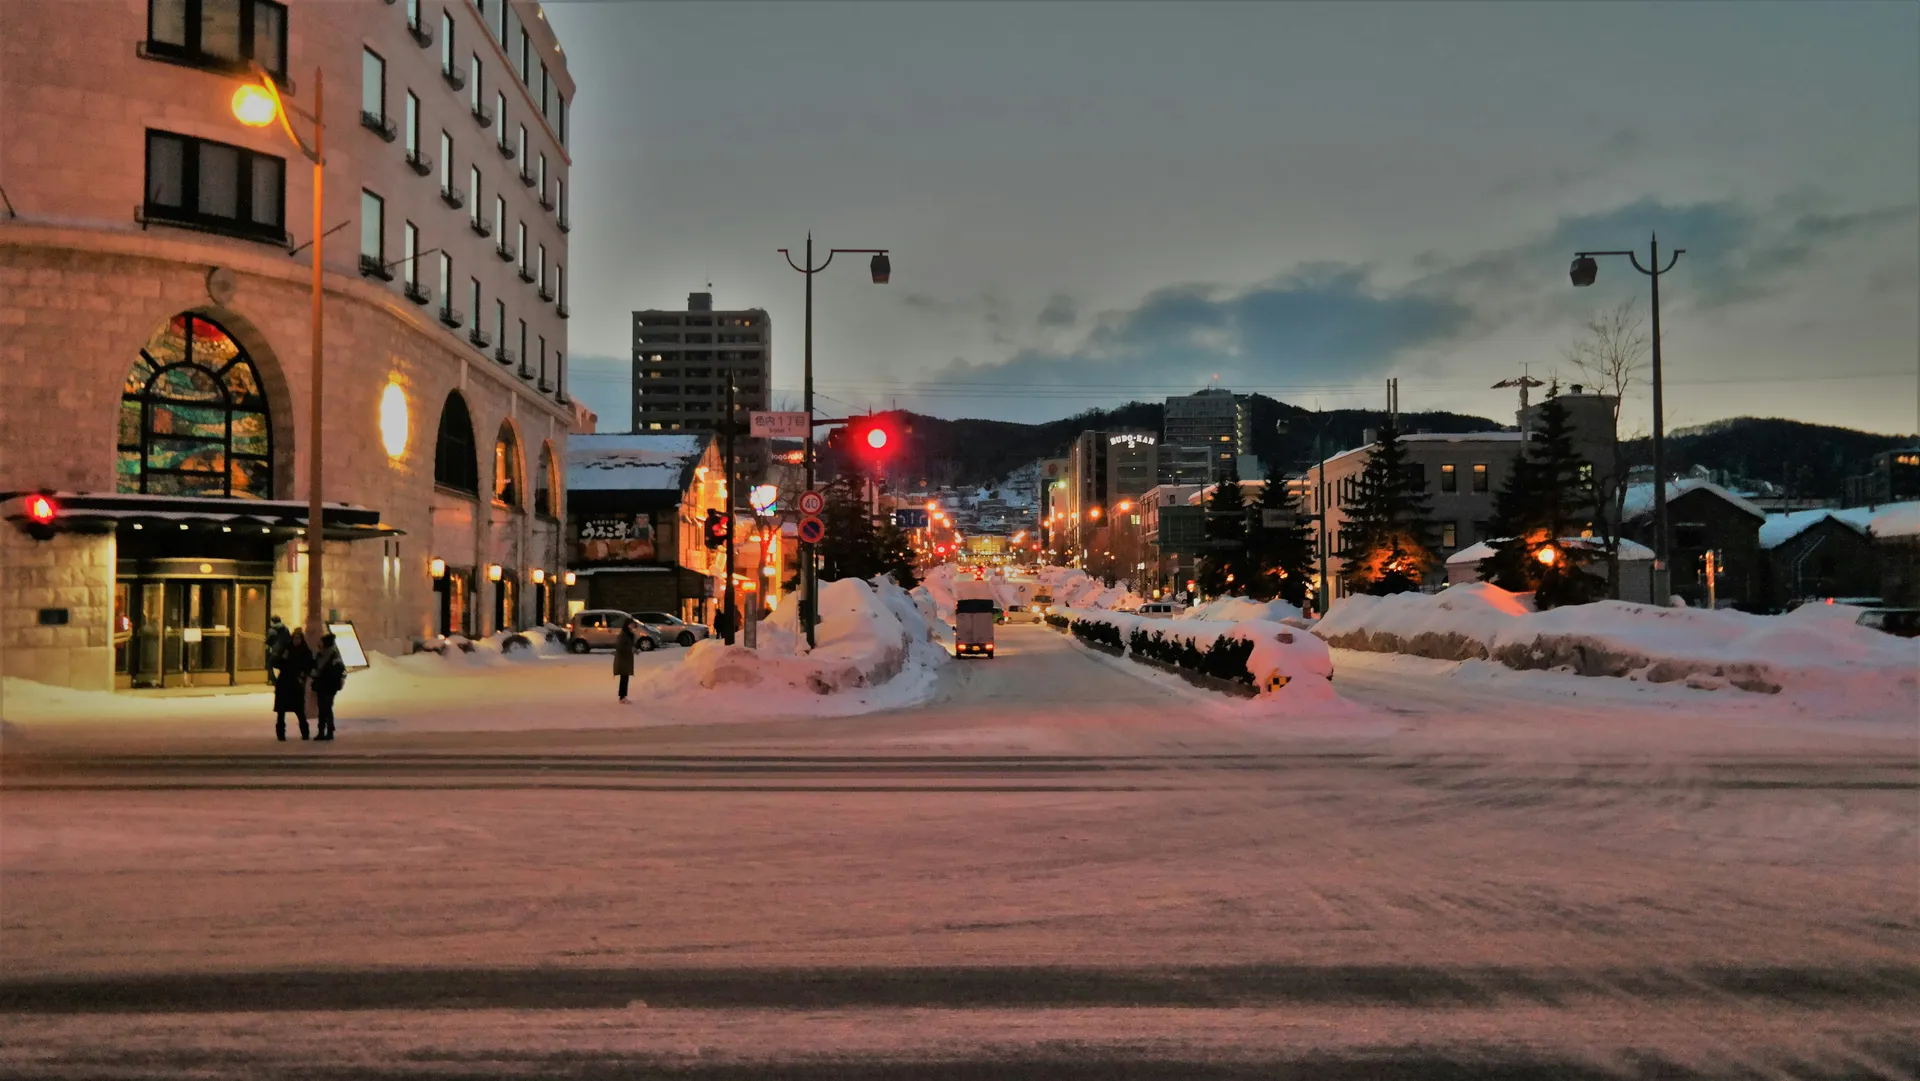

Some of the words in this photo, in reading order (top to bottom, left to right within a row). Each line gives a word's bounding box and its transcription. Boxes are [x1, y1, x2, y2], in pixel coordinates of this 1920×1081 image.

[805, 498, 818, 509] 40
[581, 521, 630, 540] うろこ亭
